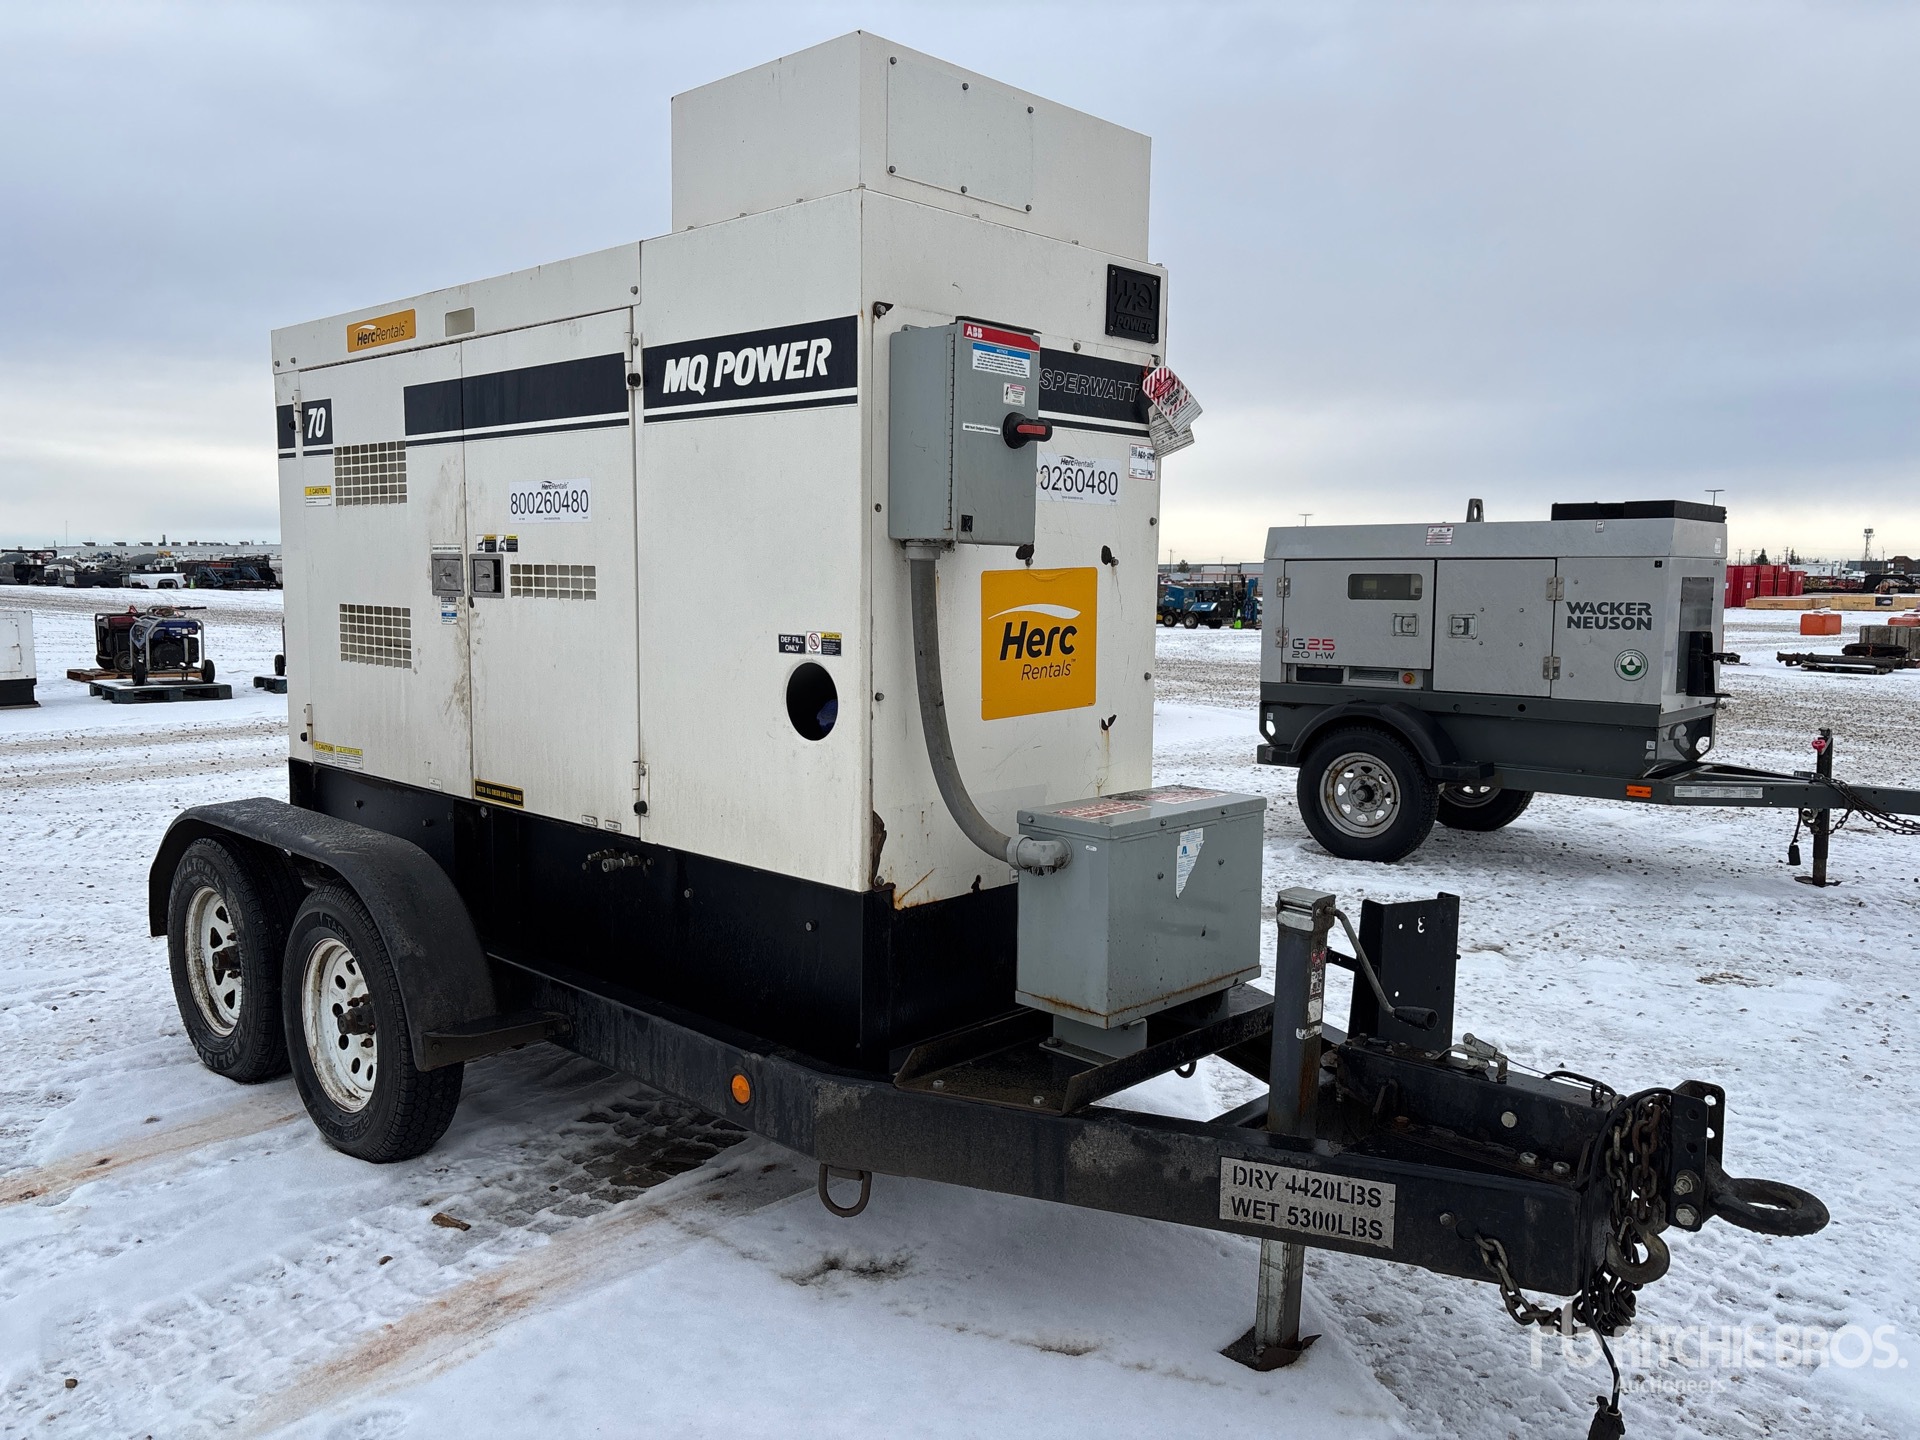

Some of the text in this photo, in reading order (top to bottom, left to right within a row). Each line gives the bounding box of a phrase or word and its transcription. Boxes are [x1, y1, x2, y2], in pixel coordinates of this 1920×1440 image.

[966, 326, 983, 338] ABB
[663, 338, 832, 396] MQ POWER
[1039, 368, 1140, 402] SPERWATT
[1163, 388, 1180, 405] LOCKED
[307, 407, 326, 439] 70
[1038, 465, 1118, 496] 0260480
[510, 489, 589, 515] 800260480
[1566, 601, 1653, 616] WACKER
[1567, 616, 1653, 631] NEUSON
[780, 635, 803, 644] DEF FILL
[1000, 621, 1078, 661] Herc
[1292, 638, 1335, 651] G25
[1232, 1165, 1382, 1208] DRY 4420LBS
[1231, 1196, 1383, 1241] WET 5300LBS
